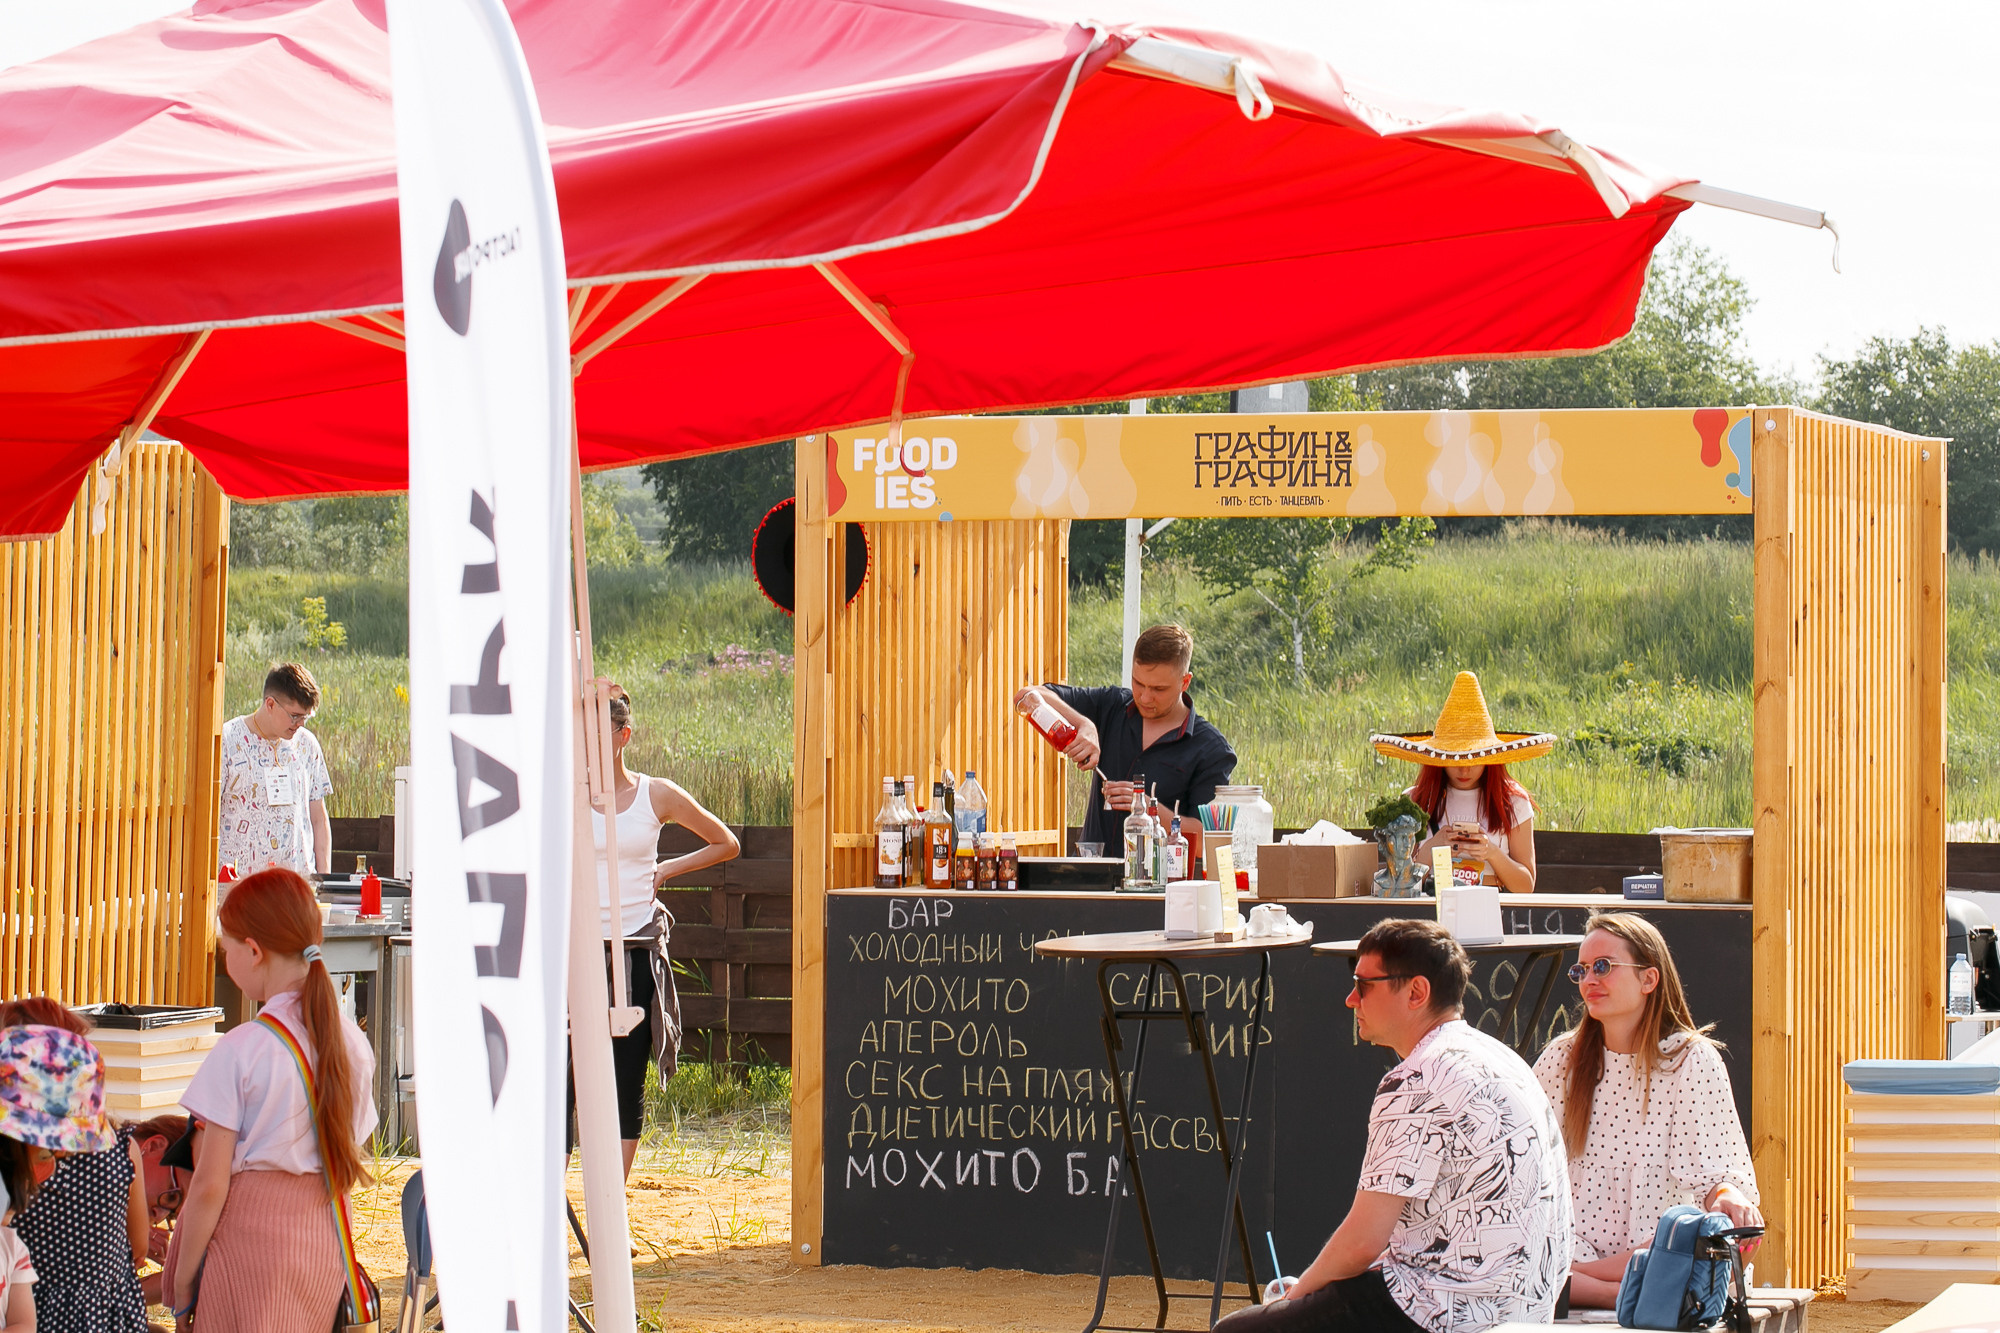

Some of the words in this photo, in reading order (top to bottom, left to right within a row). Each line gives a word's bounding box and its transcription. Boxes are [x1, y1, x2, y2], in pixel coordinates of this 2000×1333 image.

[853, 437, 958, 474] FOOD
[1194, 459, 1353, 488] ГРАФИНЯ
[875, 475, 936, 509] IES
[1220, 495, 1243, 507] ПИТЬ
[1249, 495, 1273, 507] ЕСТЬ
[1279, 495, 1325, 507] ТАНЦЕВАТЬ
[1453, 868, 1479, 880] FOOD
[888, 898, 954, 930] БАР
[884, 974, 1031, 1016] МОХИТО
[859, 1020, 1028, 1060] АПЕРОЛЬ
[845, 1060, 944, 1100] СЕКС
[963, 1065, 1012, 1097] НА
[845, 1148, 1042, 1193] МОХИТО
